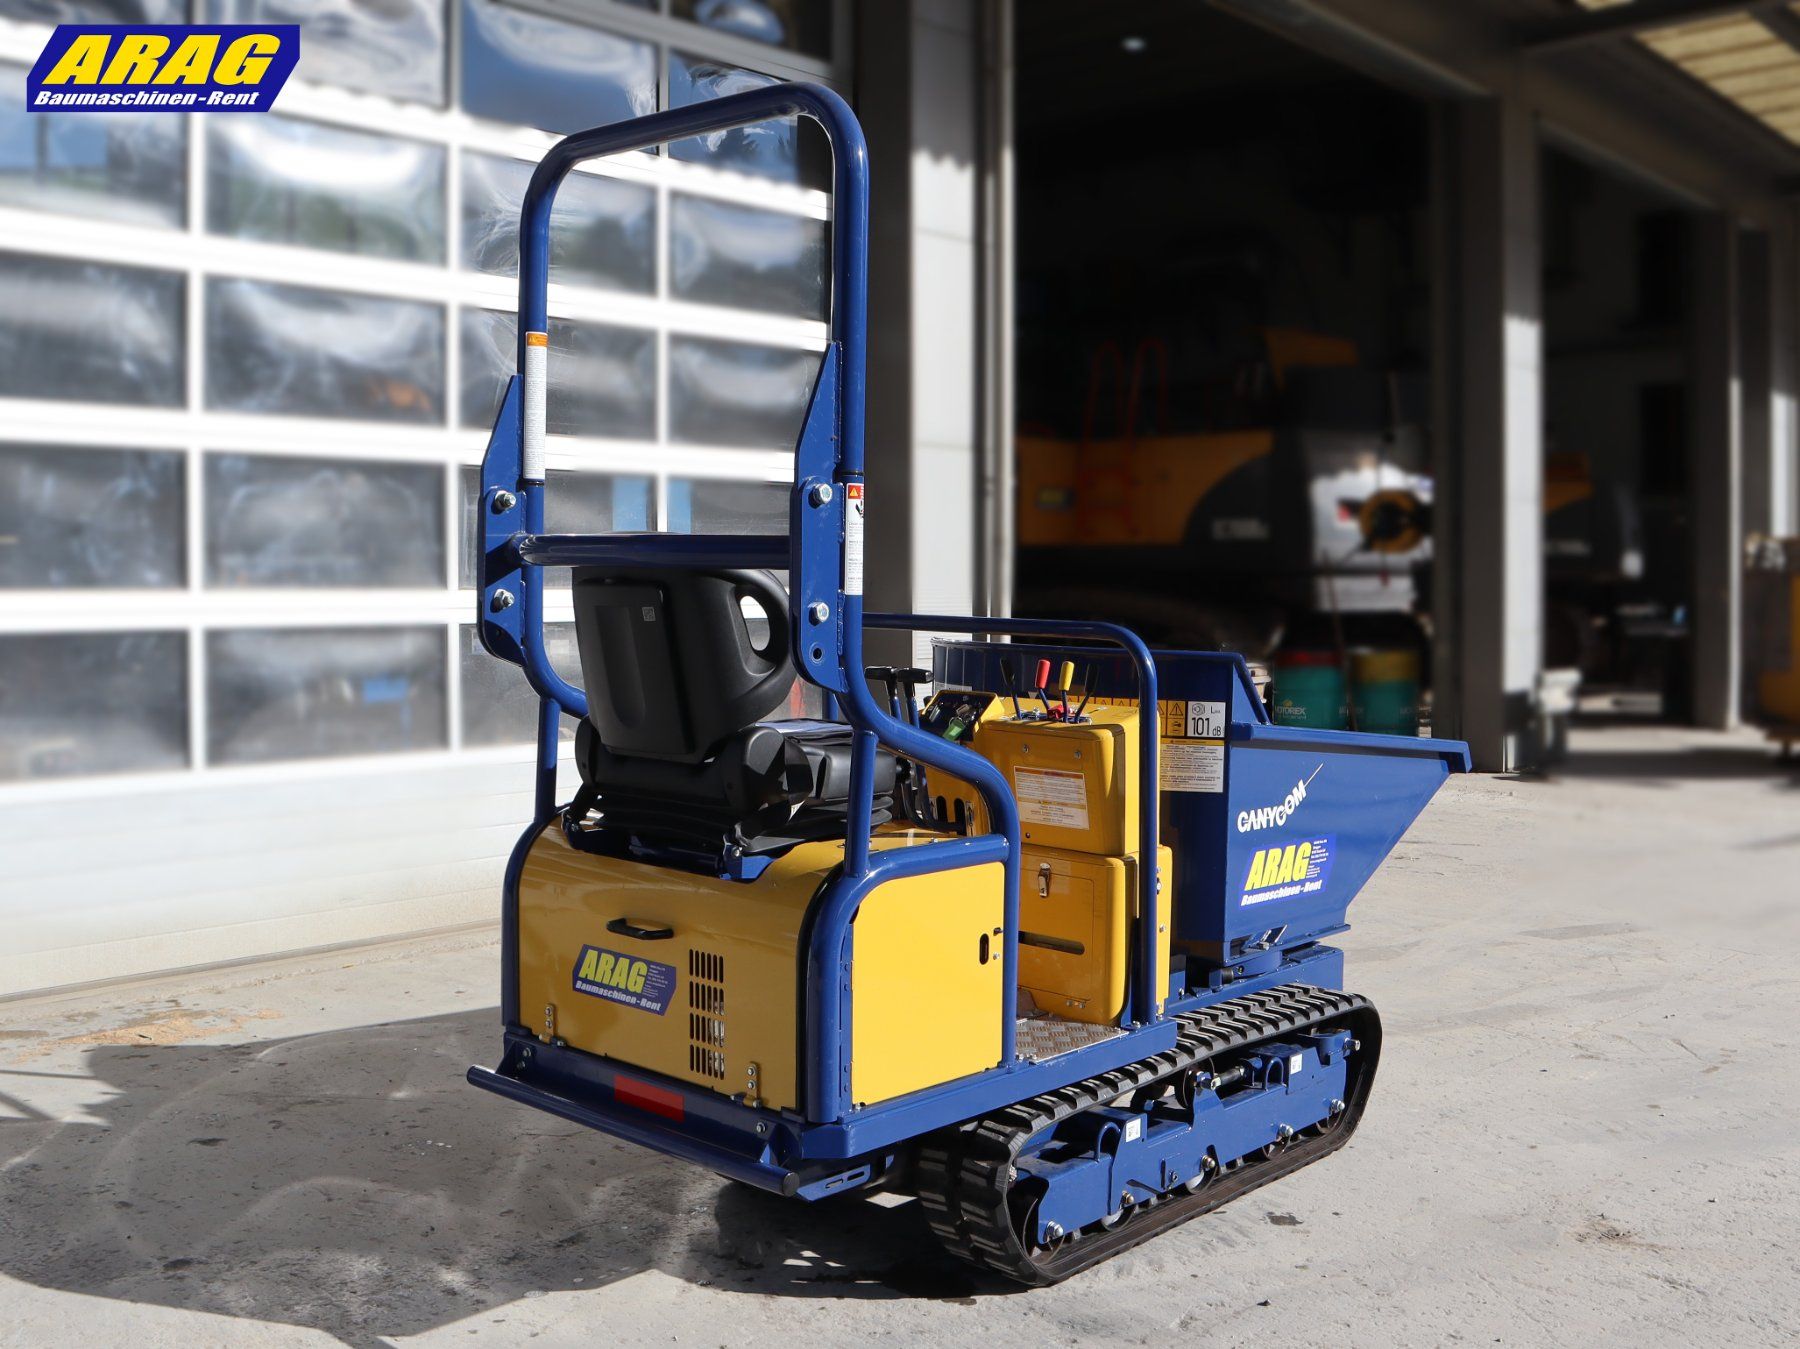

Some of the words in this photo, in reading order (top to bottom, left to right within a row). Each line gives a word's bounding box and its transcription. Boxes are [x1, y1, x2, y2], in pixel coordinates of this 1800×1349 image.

[1191, 717, 1210, 736] 101
[1212, 726, 1222, 737] dB
[1237, 778, 1308, 834] CANYCOM
[1243, 841, 1313, 892] ARAG
[1240, 879, 1323, 907] Baumaschinen-Rent
[578, 948, 648, 994] ARAG
[575, 980, 662, 1011] Baumaschinen-Rent
